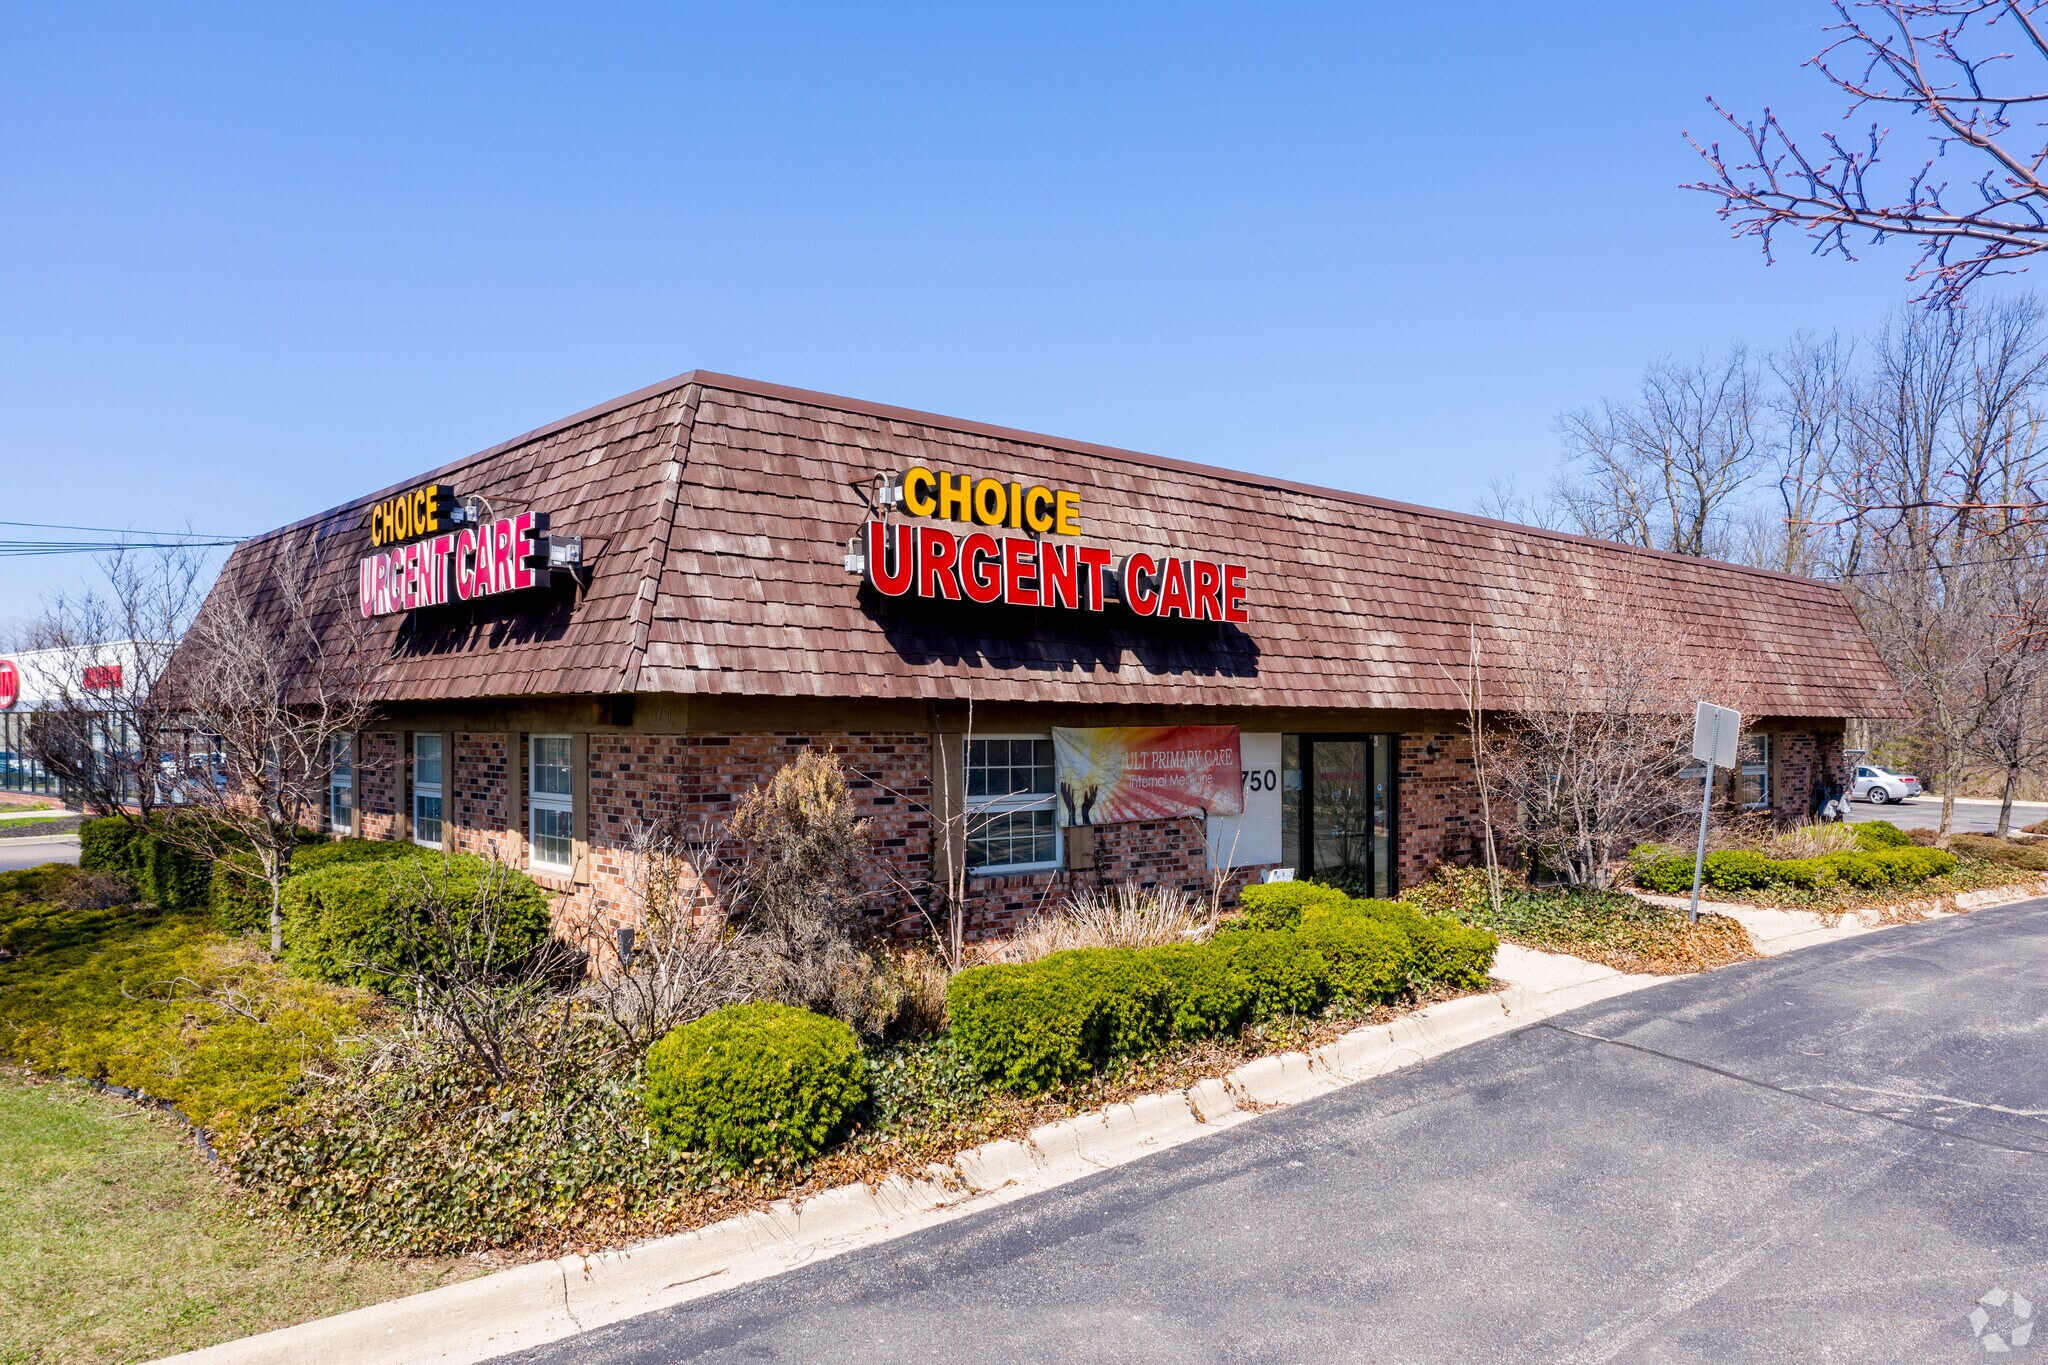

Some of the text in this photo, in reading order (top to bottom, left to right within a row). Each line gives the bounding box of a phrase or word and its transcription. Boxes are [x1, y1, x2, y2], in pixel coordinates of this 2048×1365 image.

[371, 484, 439, 547] CHOICE
[902, 466, 1081, 536] CHOICE
[359, 510, 536, 619] URGENT CARE
[867, 520, 1250, 624] URGENT CARE
[1129, 774, 1167, 788] Internal
[1151, 750, 1202, 769] PRIMARY
